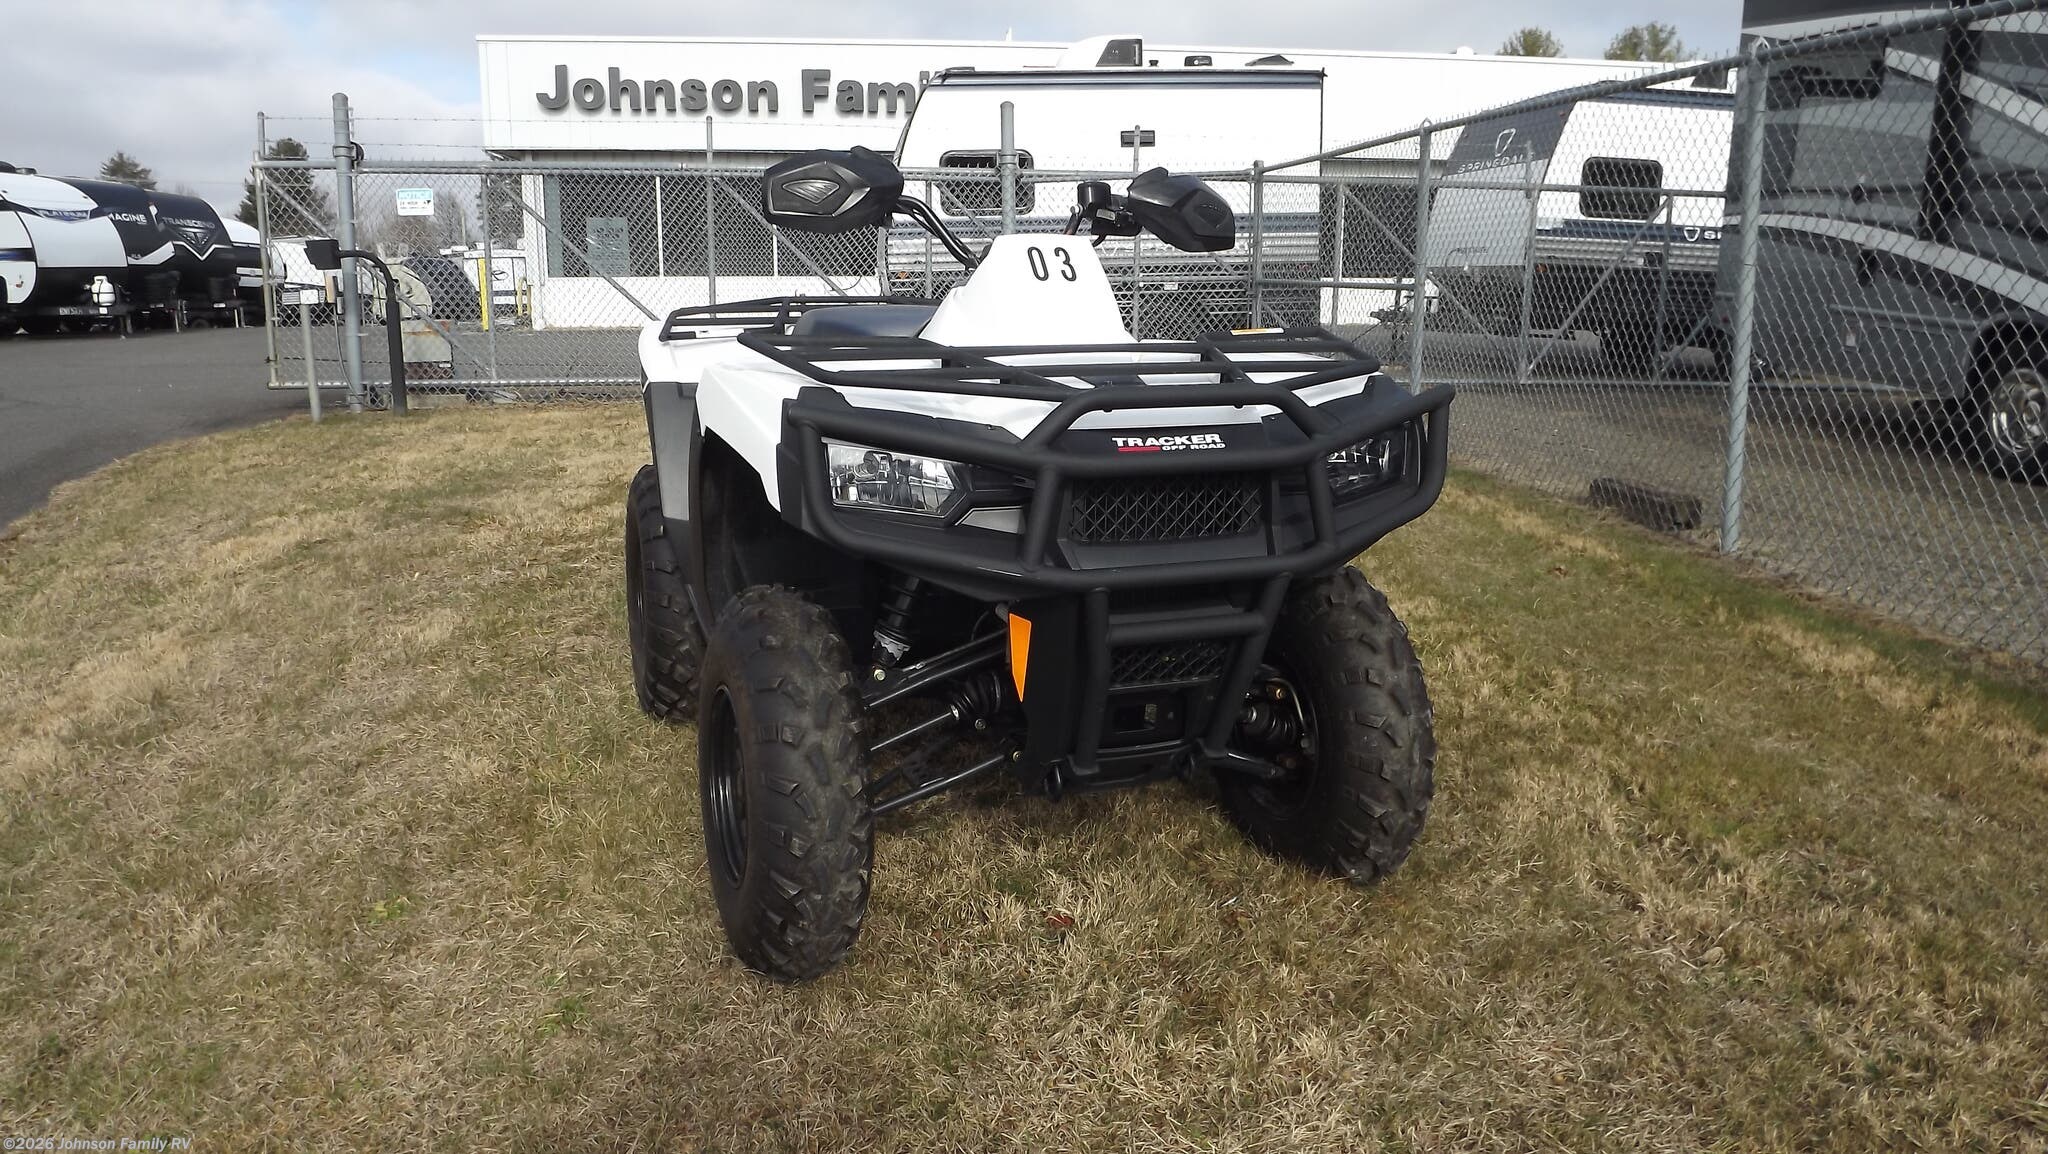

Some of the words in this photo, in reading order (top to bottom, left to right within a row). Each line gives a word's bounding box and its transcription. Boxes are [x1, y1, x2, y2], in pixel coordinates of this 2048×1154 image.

[536, 64, 779, 112] Johnson
[109, 213, 147, 223] MAGINE
[1027, 246, 1077, 281] 03
[1112, 433, 1222, 447] TRACKER
[1190, 442, 1226, 450] ROAD
